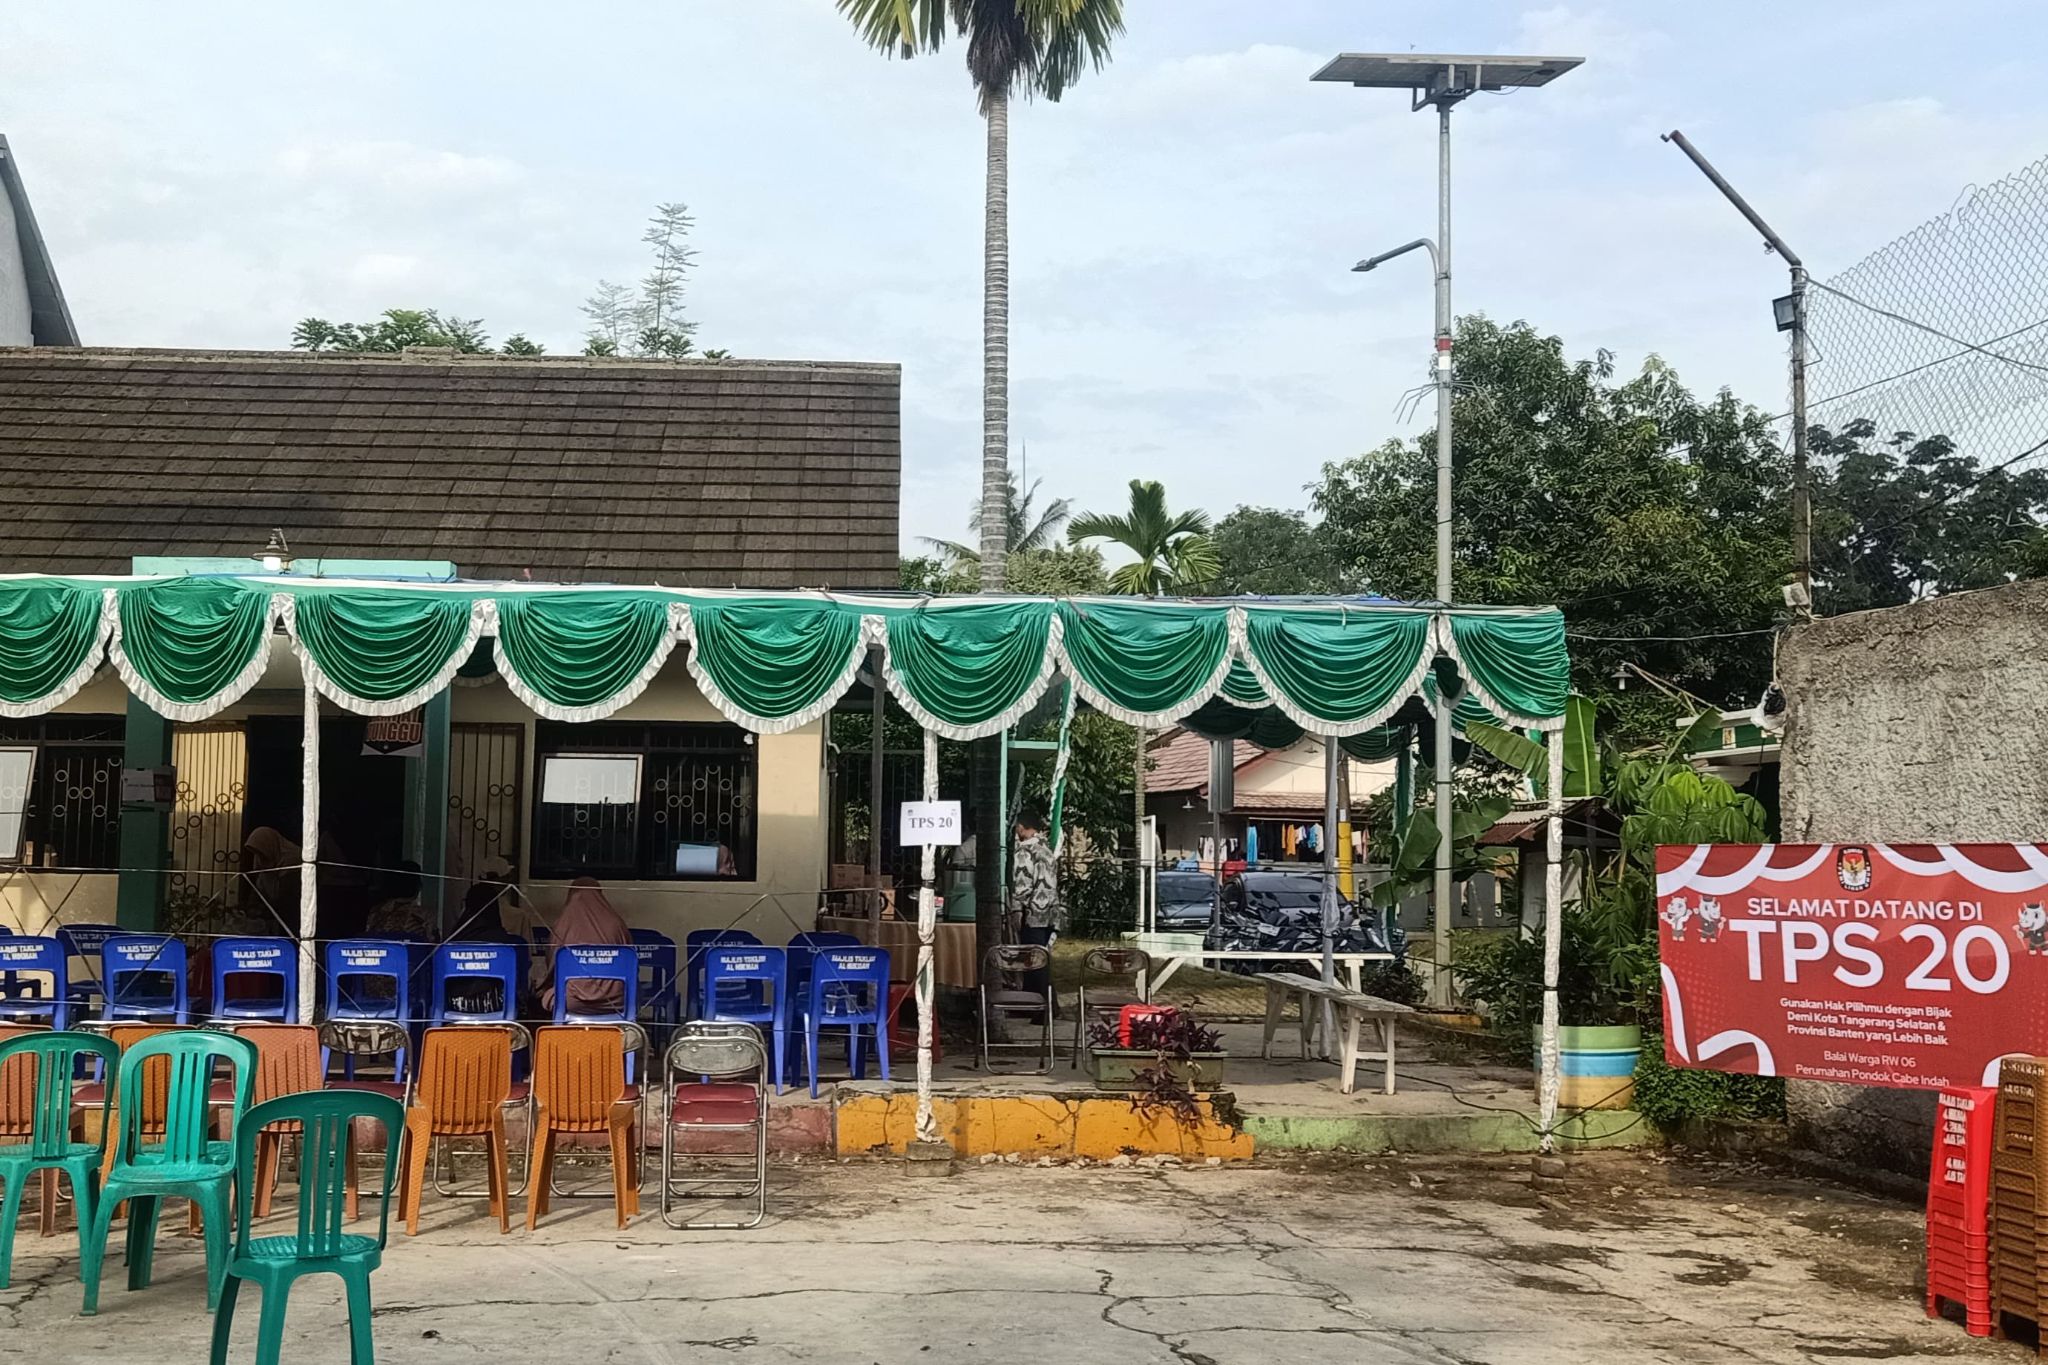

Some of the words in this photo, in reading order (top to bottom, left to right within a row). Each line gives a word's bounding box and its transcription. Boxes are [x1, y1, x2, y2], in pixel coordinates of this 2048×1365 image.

[908, 817, 935, 828] TPS
[938, 817, 953, 828] 20
[1747, 897, 1850, 918] SELAMAT
[1854, 899, 1954, 920] DATANG
[1958, 901, 1983, 921] DI
[1728, 919, 1884, 988] TPS
[1899, 923, 2011, 994] 20
[1779, 998, 1824, 1010] Gunakan
[1825, 1000, 1845, 1011] Hak
[1846, 1001, 1885, 1013] Pilihmu
[1885, 1003, 1925, 1018] dengan
[1925, 1006, 1952, 1020] Bijak
[1787, 1011, 1813, 1022] Demi
[1814, 1013, 1838, 1024] Kota
[1838, 1014, 1895, 1030] Tangerang
[1896, 1018, 1936, 1030] Selatan
[1937, 1021, 1946, 1032] &
[1787, 1025, 1827, 1036] Provinsi
[1828, 1027, 1865, 1040] Banten
[1866, 1031, 1892, 1044] yang
[1893, 1031, 1924, 1044] Lebih
[1924, 1034, 1949, 1046] Baik
[1824, 1050, 1847, 1062] Balai
[1848, 1052, 1880, 1067] Warga
[1881, 1055, 1899, 1066] RW
[1900, 1056, 1916, 1068] 06
[1795, 1063, 1851, 1078] Perumahan
[1851, 1068, 1891, 1082] Pondok
[1891, 1072, 1920, 1084] Cabe
[1920, 1075, 1950, 1087] Indah
